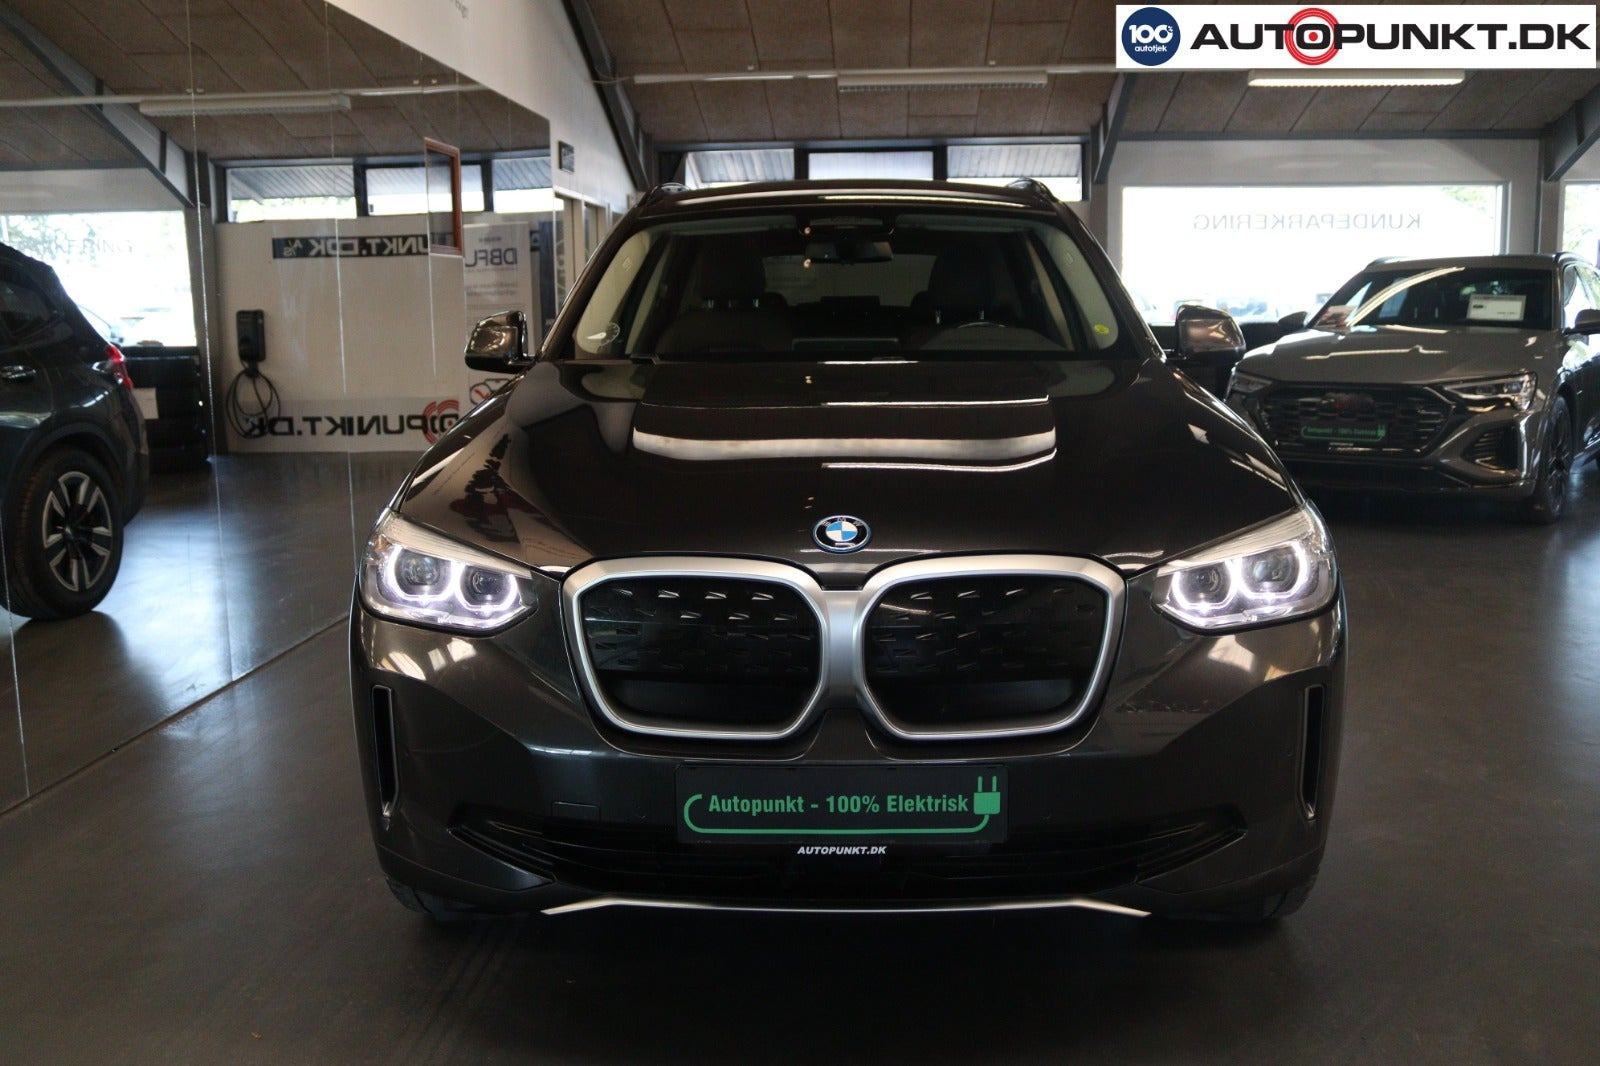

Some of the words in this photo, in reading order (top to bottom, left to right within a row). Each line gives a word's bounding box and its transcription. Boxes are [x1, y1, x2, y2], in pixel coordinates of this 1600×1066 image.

[708, 795, 804, 816] Autopunkt
[826, 795, 880, 813] 100%
[887, 795, 968, 812] Elektrisk
[796, 846, 887, 855] AUTOPUNKT.DK
